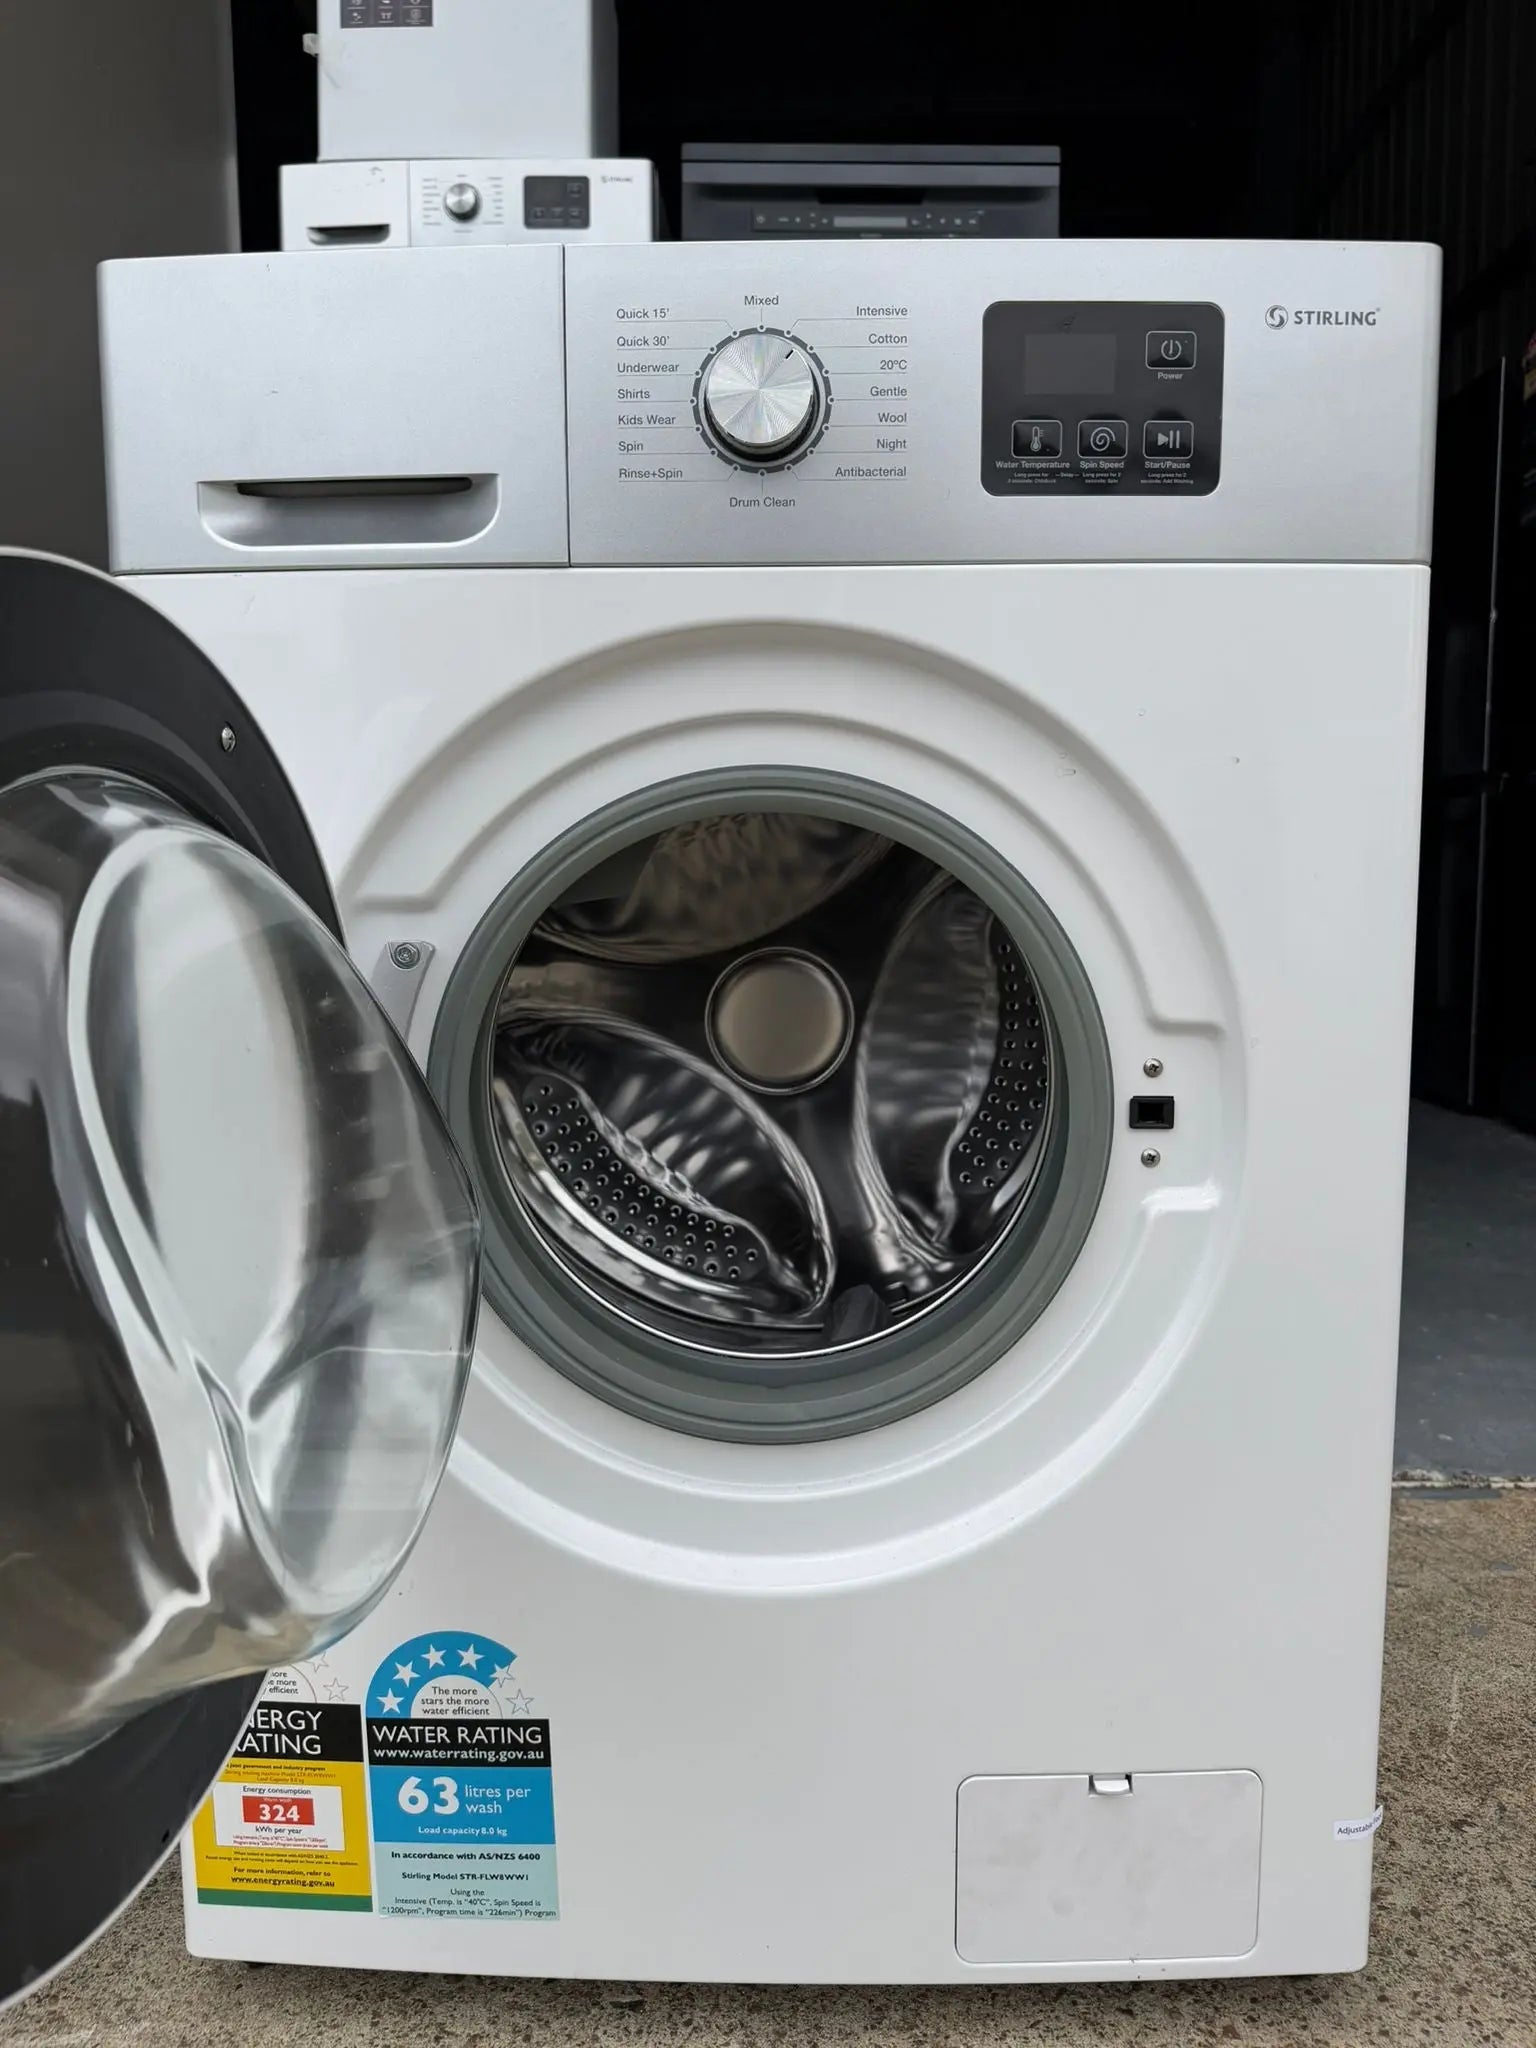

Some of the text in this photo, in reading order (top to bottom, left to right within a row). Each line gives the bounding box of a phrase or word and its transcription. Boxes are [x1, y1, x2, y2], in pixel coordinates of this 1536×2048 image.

[744, 295, 779, 306] Mixed
[616, 308, 670, 319] Quick 15'
[856, 306, 908, 317] Intensive
[1293, 310, 1377, 326] STIRLING
[616, 335, 670, 347] Quick 30'
[868, 333, 908, 344] Cotton
[617, 362, 679, 373] Underwear
[880, 360, 908, 371] 20°C
[1157, 372, 1183, 381] Power
[617, 388, 650, 399] Shirts
[869, 386, 908, 397] Gentle
[618, 415, 676, 426] Kids Wear
[877, 412, 907, 423] Wool
[618, 441, 644, 453] Spin
[876, 439, 907, 451] Night
[995, 461, 1070, 470] Water Temperature
[1079, 461, 1125, 470] Spin Speed
[1144, 461, 1191, 469] Start/Pause
[619, 468, 683, 480] Rinse+Spin
[835, 466, 907, 477] Antibacterial
[729, 497, 796, 508] Drum Clean
[269, 1686, 299, 1695] efficient
[432, 1686, 478, 1695] The more
[421, 1697, 490, 1706] stars the more
[422, 1707, 490, 1716] water efficient
[248, 1708, 323, 1731] ERGY
[372, 1725, 543, 1745] WATER RATING
[374, 1749, 545, 1763] www.waterrating.gov.au
[242, 1786, 312, 1796] Energy consumption
[398, 1775, 460, 1815] 63
[464, 1784, 532, 1801] litres per
[259, 1803, 300, 1822] 324
[465, 1801, 503, 1814] wash
[274, 1827, 286, 1835] per
[418, 1826, 508, 1837] Load capacity 8.0 kg
[391, 1851, 541, 1861] In accordance with AS/NZS 6400
[231, 1876, 335, 1888] www.energyrating.gov.au
[401, 1872, 431, 1881] Stirling
[433, 1872, 458, 1880] Model
[450, 1888, 471, 1897] Using
[395, 1897, 426, 1905] Intensive
[494, 1899, 509, 1908] Spin
[511, 1899, 533, 1908] Speed
[426, 1908, 458, 1917] Program
[459, 1908, 475, 1916] time
[525, 1910, 557, 1919] Program
